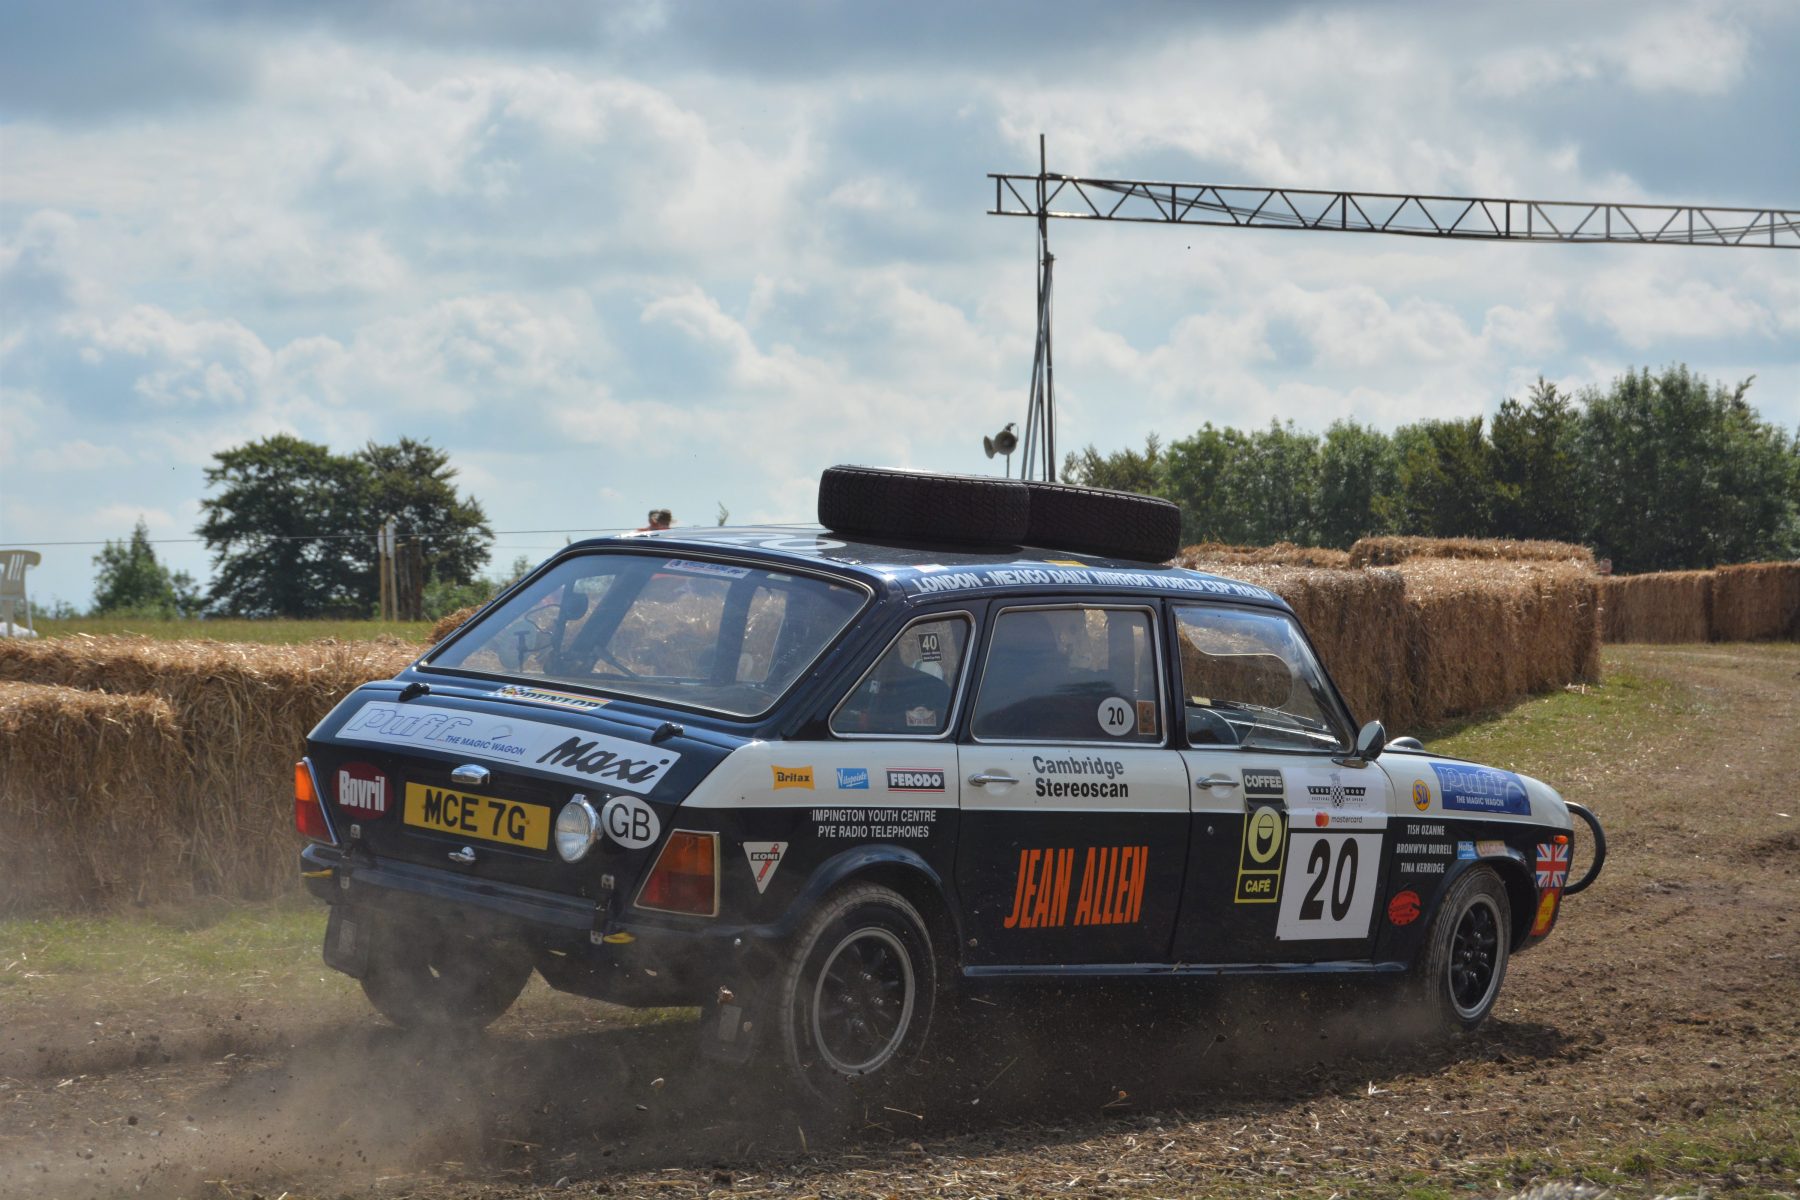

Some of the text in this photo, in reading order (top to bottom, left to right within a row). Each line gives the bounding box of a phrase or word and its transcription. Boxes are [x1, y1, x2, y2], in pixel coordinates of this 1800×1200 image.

[911, 573, 983, 592] LONDON
[987, 570, 1051, 586] MEXICO
[1050, 570, 1093, 585] DAILY
[1091, 571, 1153, 586] MIRROR
[1151, 575, 1203, 591] WORLD
[1202, 580, 1231, 594] CUP
[1229, 583, 1274, 600] RALLY
[922, 635, 937, 651] 40
[523, 692, 600, 707] DUNLOP
[1107, 706, 1125, 726] 20
[460, 737, 491, 750] MAGIC
[491, 743, 526, 756] WAGON
[535, 736, 670, 784] Maxi
[1032, 755, 1125, 780] Cambridge
[776, 771, 810, 782] Britax
[890, 773, 941, 788] FERODO
[1244, 775, 1283, 789] COFFEE
[338, 769, 386, 812] Bovril
[1035, 777, 1129, 798] Stereoscan
[1456, 795, 1504, 807] THE MAGIC WAGON
[423, 788, 527, 841] MCE 7G
[609, 802, 651, 842] GB
[812, 809, 937, 822] IMPINGTON YOUTH CENTRE
[1331, 815, 1363, 824] mastercard
[817, 825, 929, 838] PYE RADIO TELEPHONES
[1407, 824, 1445, 836] TISH OZANNE
[1396, 843, 1452, 855] BRONWYN BURRELL
[1401, 862, 1445, 873] TINA KERRIDGE
[1245, 879, 1272, 893] CAFÉ
[1298, 837, 1359, 922] 20
[1003, 846, 1149, 929] JEAN ALLEN
